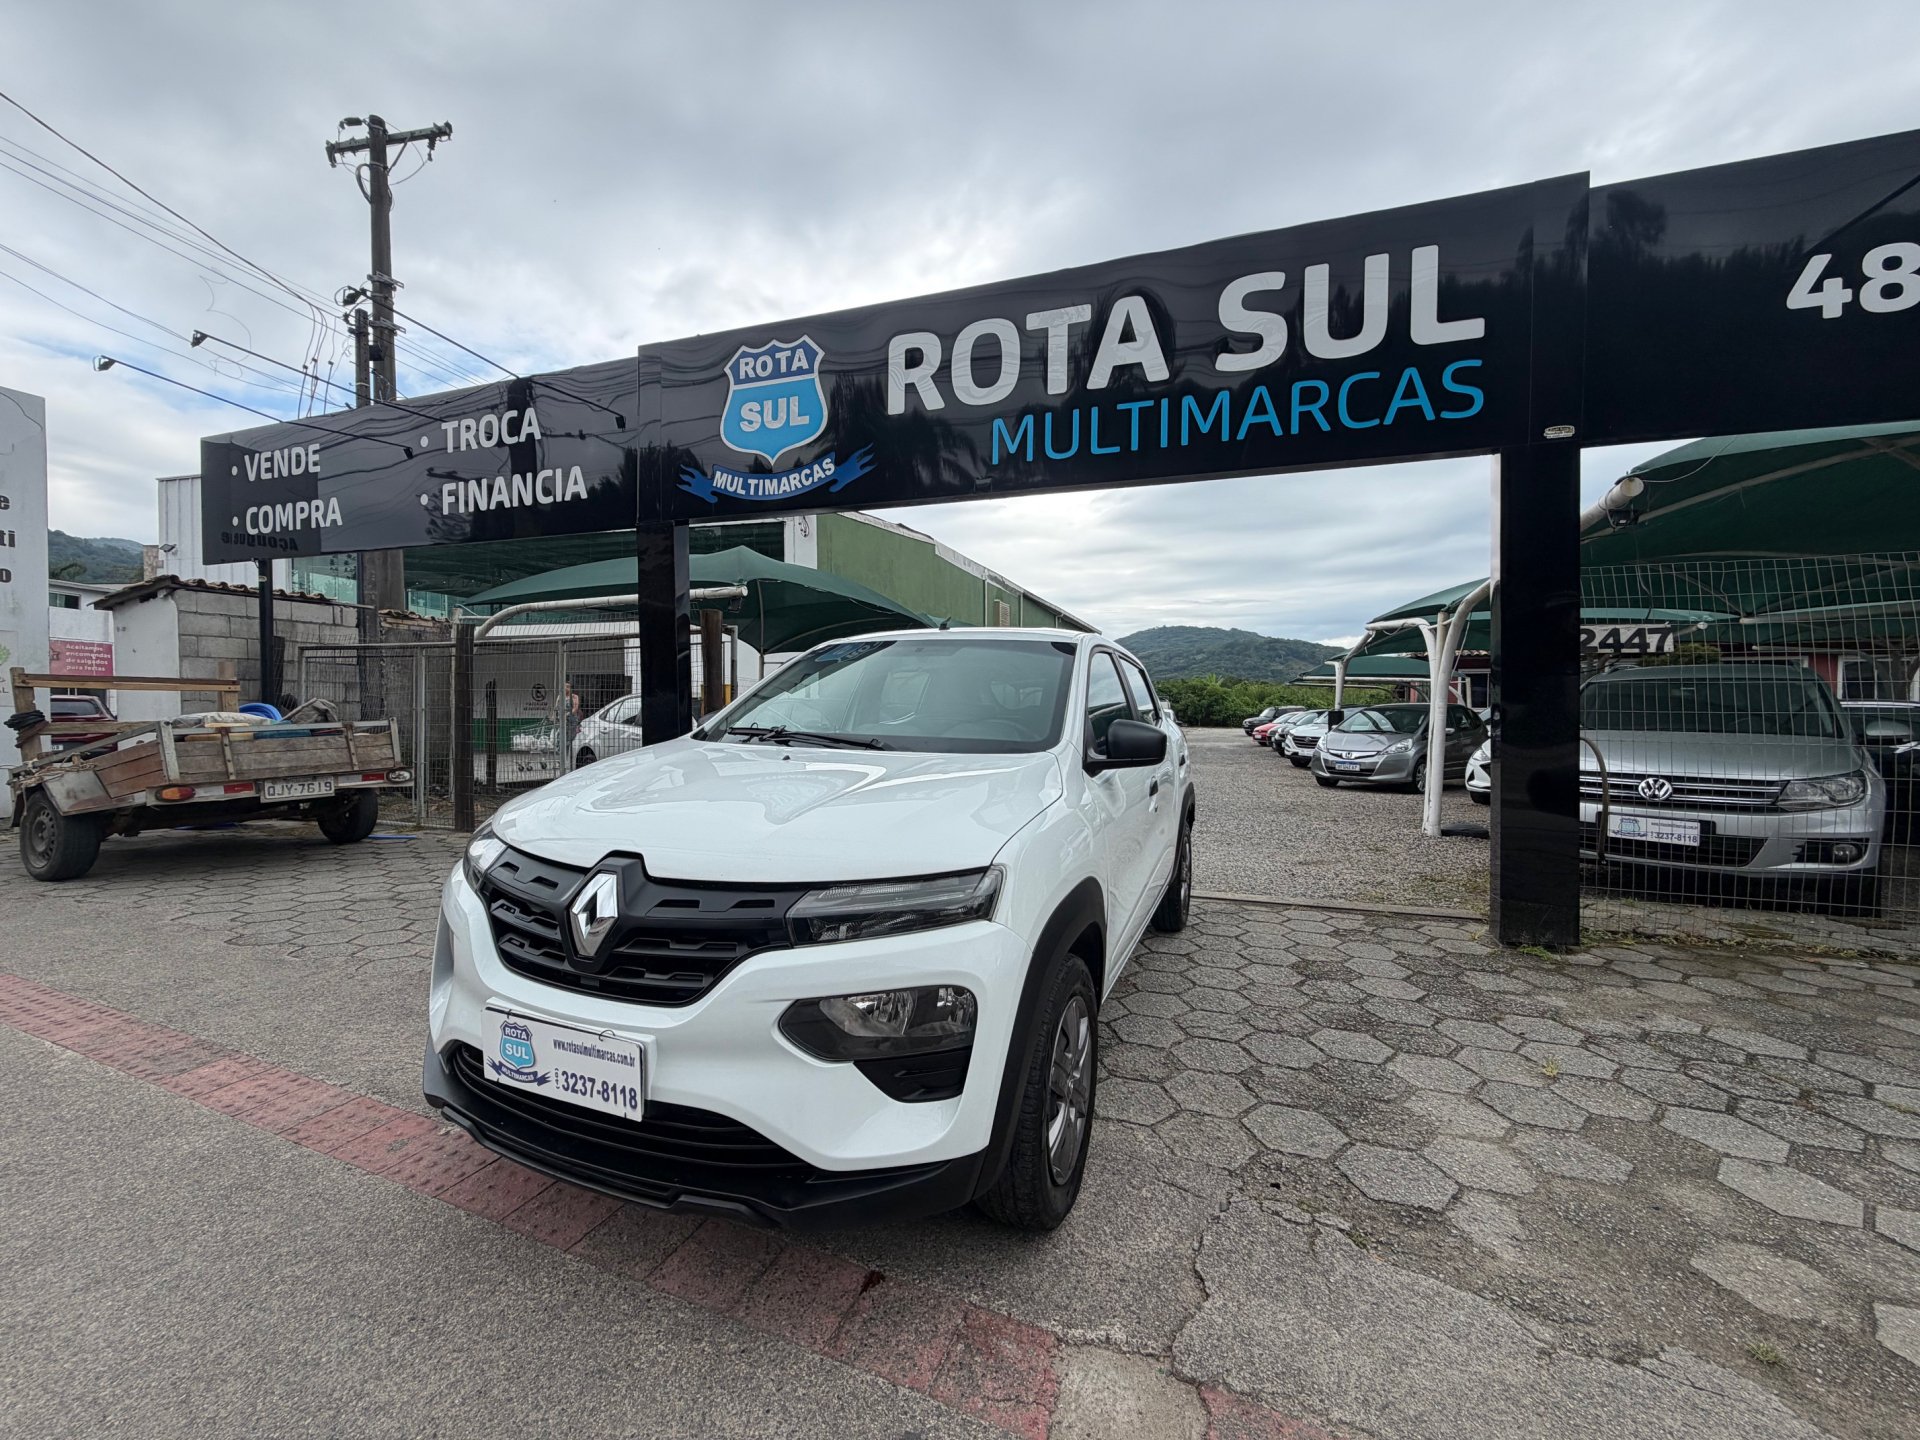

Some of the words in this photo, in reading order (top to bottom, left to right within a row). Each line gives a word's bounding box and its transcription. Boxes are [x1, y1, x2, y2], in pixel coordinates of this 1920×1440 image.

[1786, 241, 1920, 319] 48
[887, 295, 1169, 415] ROTA
[1215, 244, 1485, 371] SUL
[739, 348, 809, 380] ROTA
[441, 407, 541, 453] TROCA
[739, 396, 810, 432] SUL
[992, 359, 1484, 465] MULTIMARCAS
[244, 443, 320, 481] VENDE
[712, 457, 836, 496] MULTIMARCAS
[442, 465, 588, 515] FINANCIA
[245, 497, 343, 535] COMPRA
[505, 1028, 527, 1040] ROTA
[505, 1043, 530, 1060] SUL
[553, 1038, 636, 1068] www.rotasulmultimarcas.com.br
[501, 1066, 534, 1082] MULTIMARCAS
[561, 1070, 638, 1111] 3237-8118
